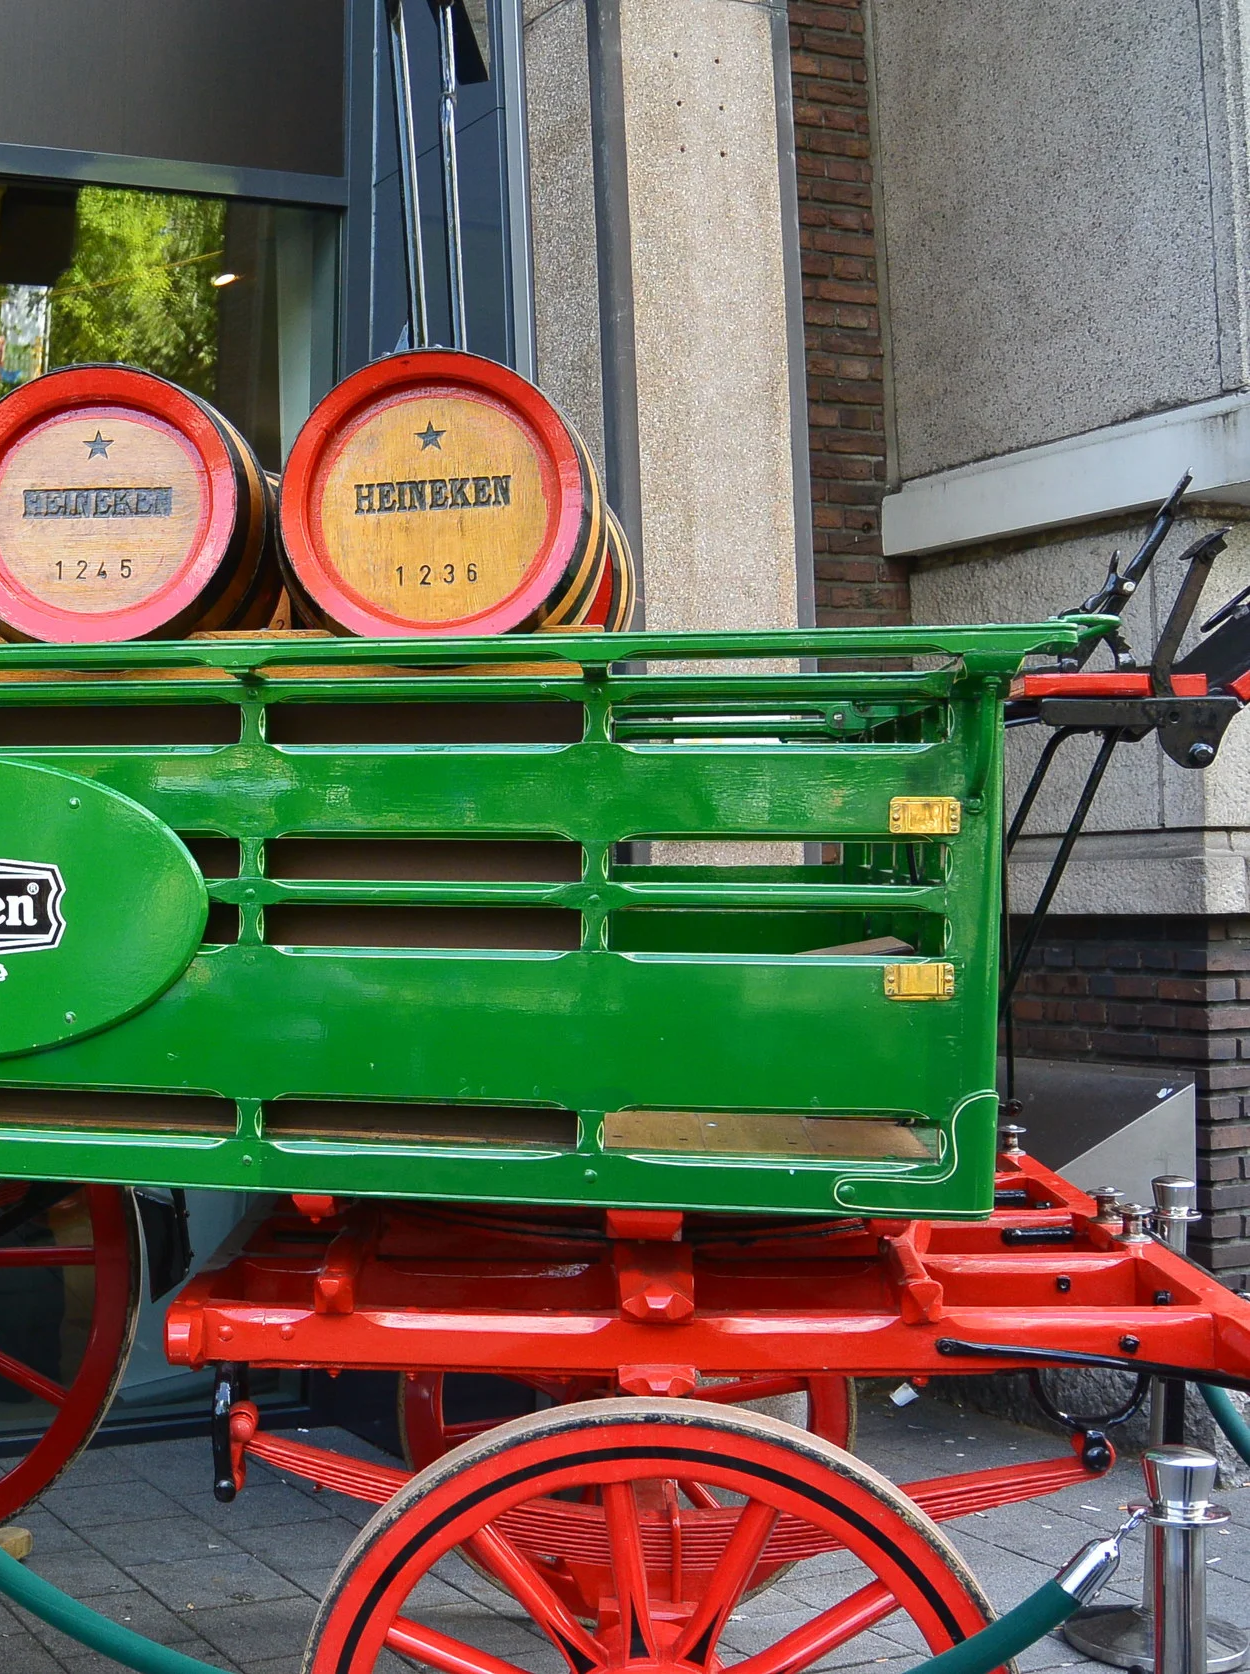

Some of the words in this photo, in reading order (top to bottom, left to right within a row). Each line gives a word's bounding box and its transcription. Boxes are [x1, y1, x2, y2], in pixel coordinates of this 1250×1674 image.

[22, 486, 174, 520] HEINEKEN
[354, 474, 512, 516] HEINEKEN
[53, 558, 133, 581] 1245
[395, 562, 478, 587] 1236
